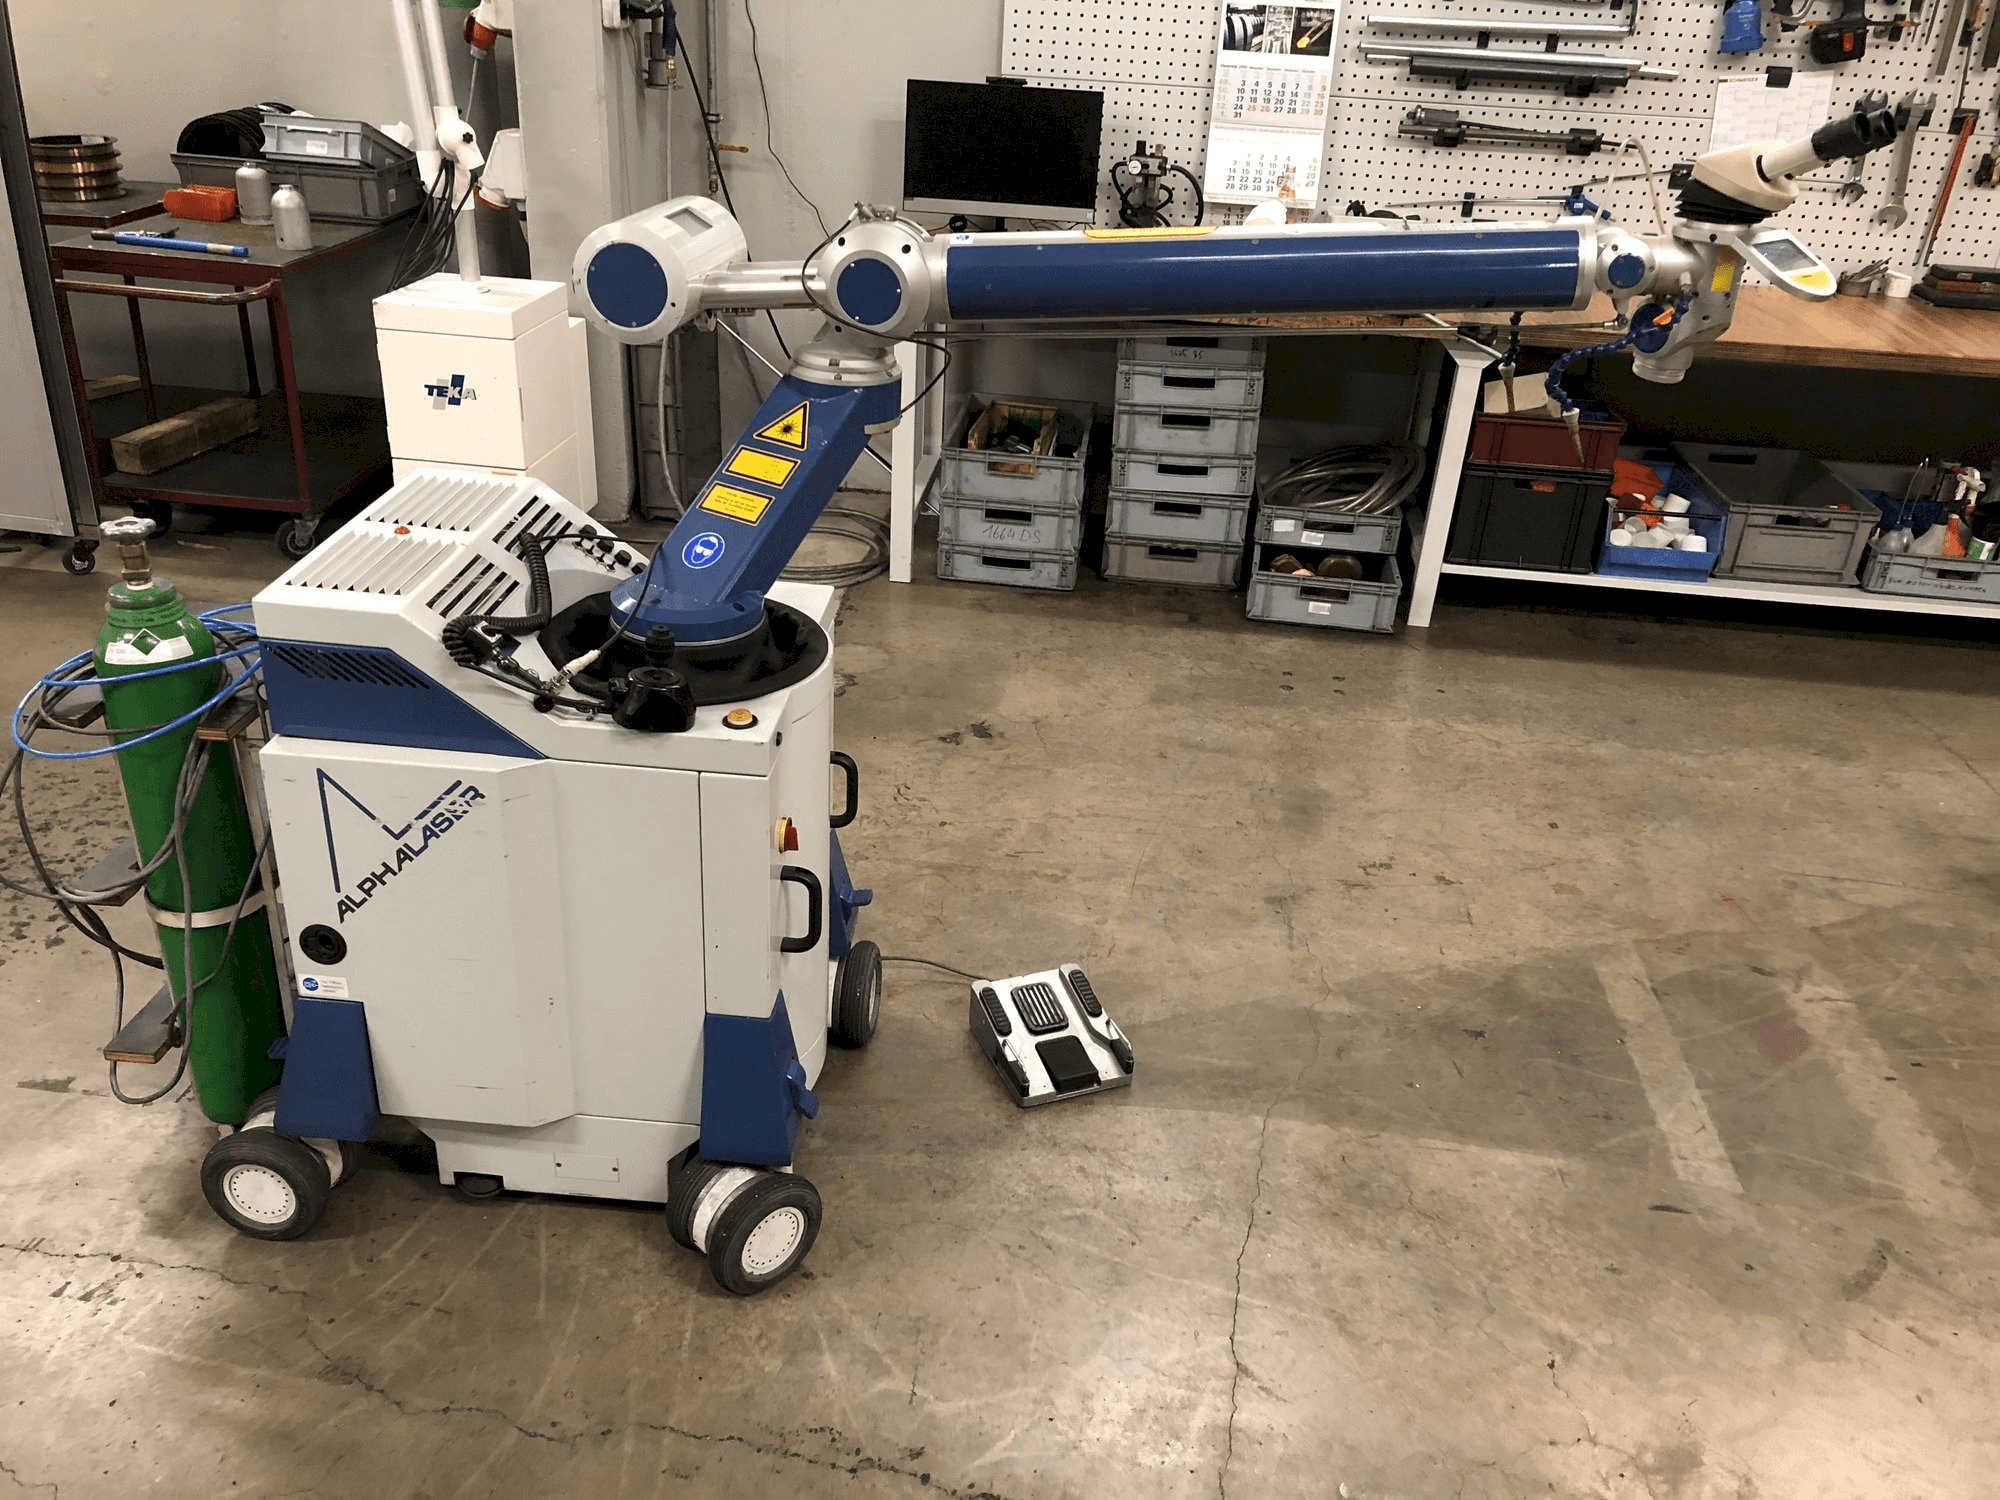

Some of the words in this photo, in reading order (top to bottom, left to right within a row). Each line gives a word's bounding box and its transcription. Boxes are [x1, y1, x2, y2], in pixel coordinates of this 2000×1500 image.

[424, 384, 477, 400] TEKA
[982, 525, 1016, 540] 1664
[336, 786, 486, 924] ALPHALASER
